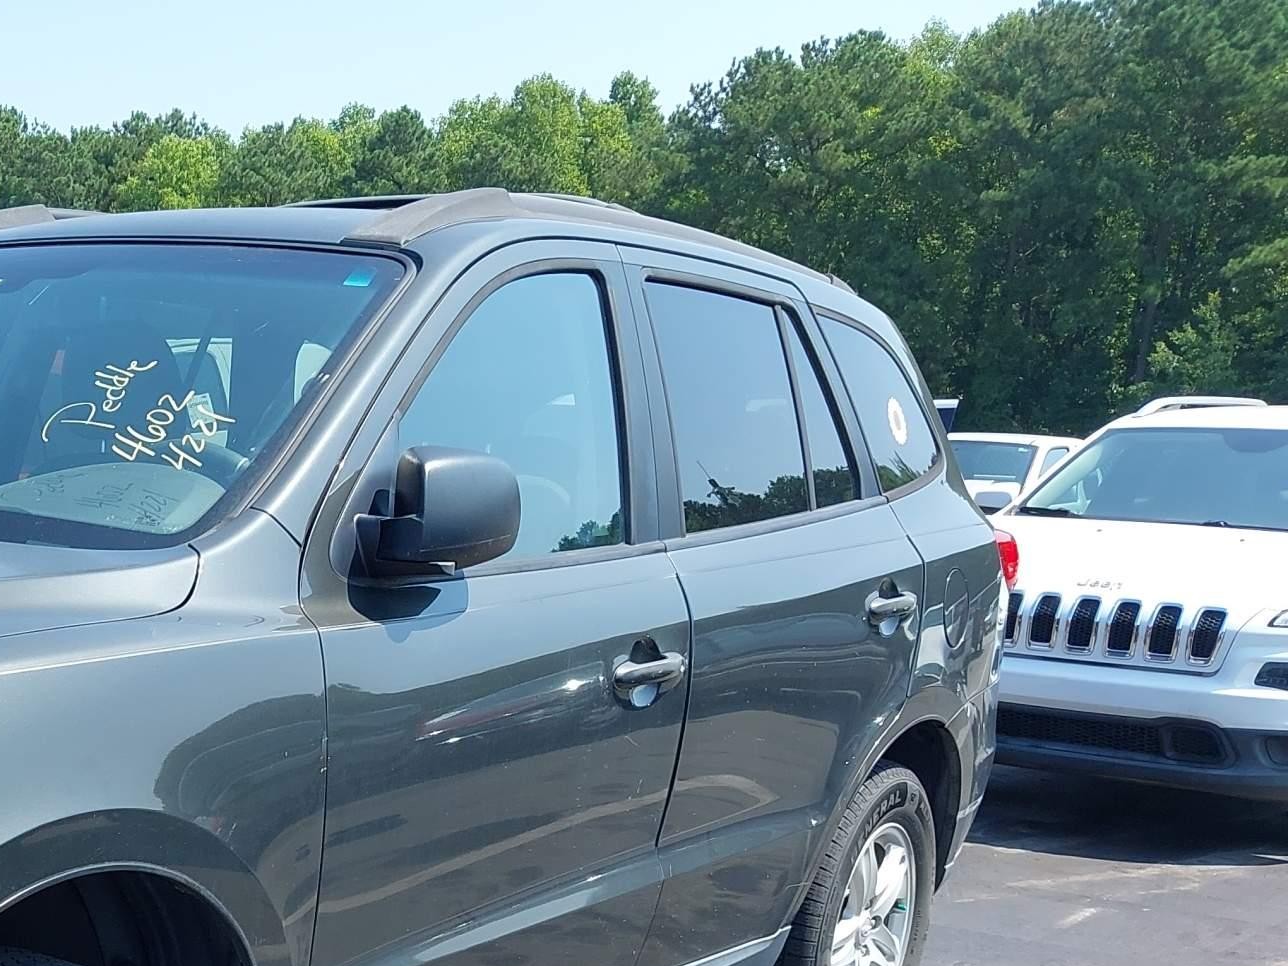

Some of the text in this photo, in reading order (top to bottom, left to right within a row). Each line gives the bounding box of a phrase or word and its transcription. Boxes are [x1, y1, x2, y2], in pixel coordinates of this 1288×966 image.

[42, 360, 158, 442] Peddle
[112, 390, 195, 461] 4602
[161, 404, 236, 470] 4221
